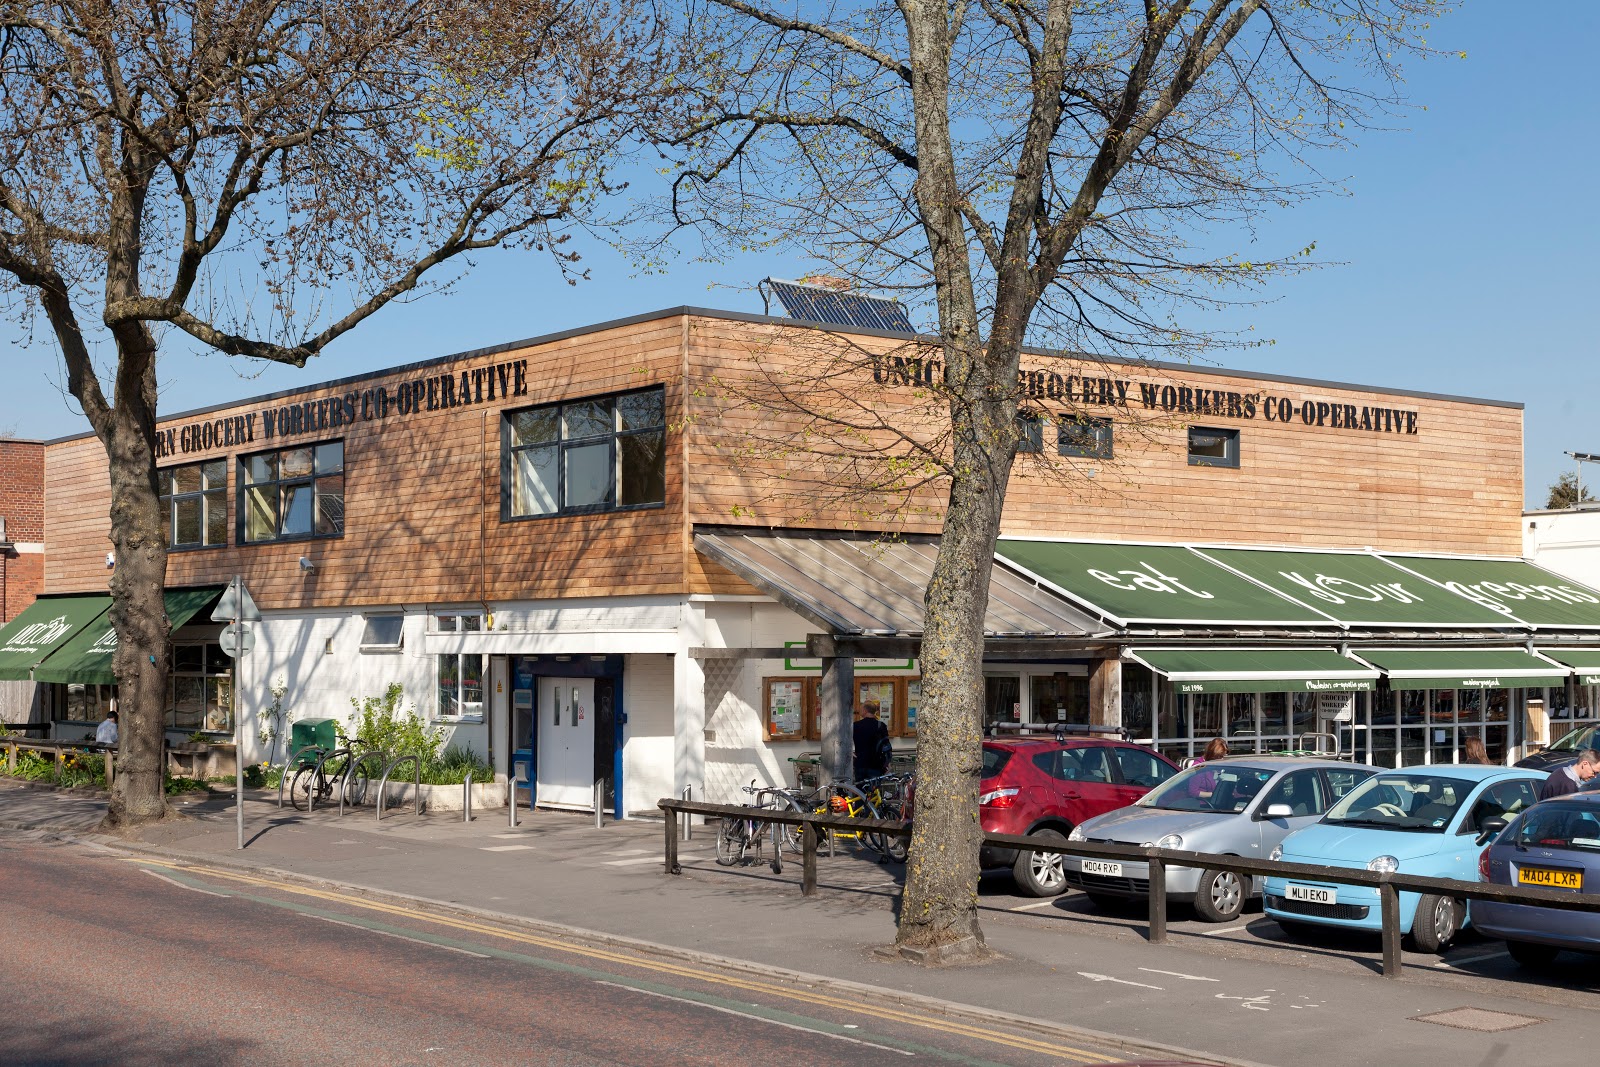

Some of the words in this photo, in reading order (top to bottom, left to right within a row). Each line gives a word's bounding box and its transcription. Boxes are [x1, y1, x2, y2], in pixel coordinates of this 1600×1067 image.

[180, 413, 257, 454] GROCERY
[361, 360, 527, 421] CO-OPERATIVE
[1263, 395, 1418, 436] CO-OPERATIVE
[1087, 561, 1214, 599] eat
[1103, 863, 1118, 874] RXP
[1523, 869, 1551, 883] MA04
[1554, 872, 1577, 886] LXR
[1310, 889, 1328, 902] EKD
